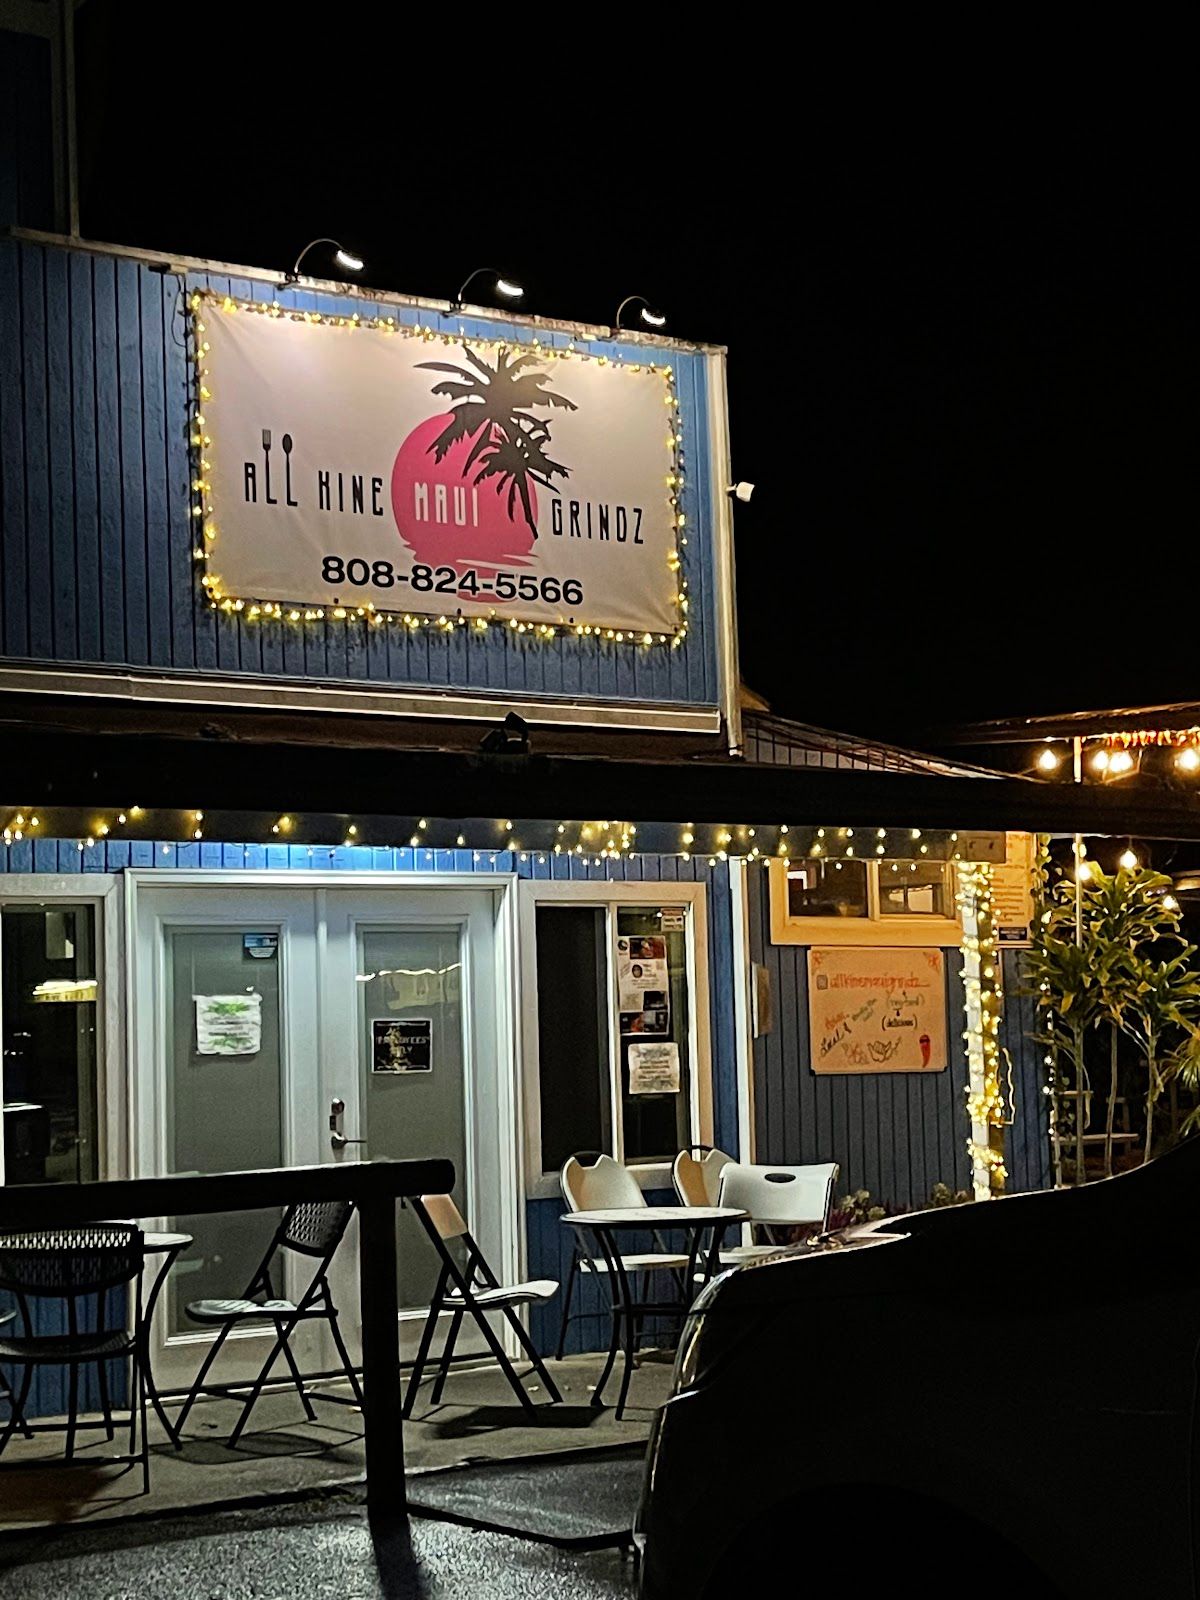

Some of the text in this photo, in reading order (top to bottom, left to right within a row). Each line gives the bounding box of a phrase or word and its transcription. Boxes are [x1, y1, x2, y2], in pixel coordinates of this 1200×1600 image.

[244, 428, 644, 545] ALL KINE MAUI GRINDZ
[321, 555, 584, 606] 808-824-5566
